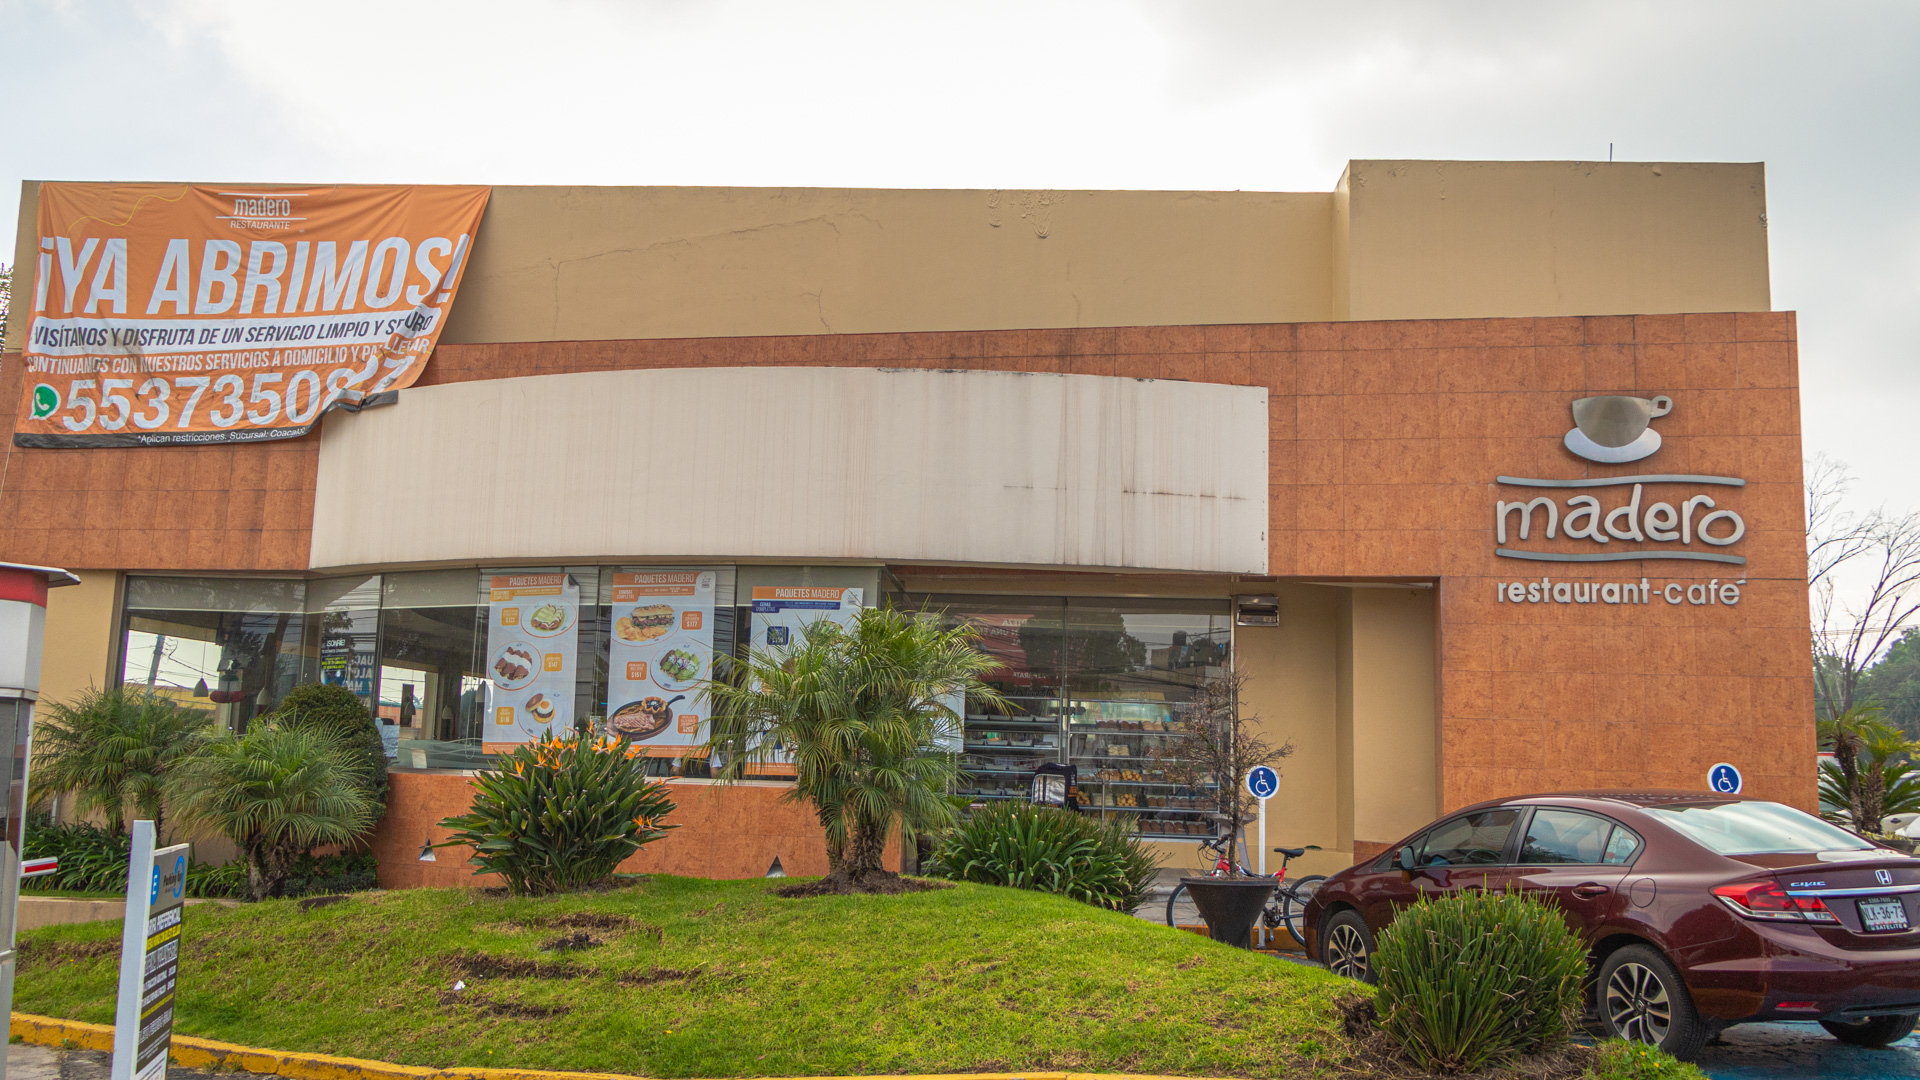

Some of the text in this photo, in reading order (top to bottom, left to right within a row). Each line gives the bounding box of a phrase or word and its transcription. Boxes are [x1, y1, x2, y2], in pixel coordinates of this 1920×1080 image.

[233, 196, 291, 216] madero
[231, 220, 290, 229] RESTAURANTE
[147, 233, 471, 315] ABRIMOS!
[34, 325, 108, 348] VISÍTANOS
[111, 328, 121, 347] Y
[123, 328, 195, 347] DISFRUTA
[198, 328, 220, 345] DE
[221, 327, 244, 344] UN
[245, 324, 316, 343] SERVICIO
[316, 320, 369, 340] LIMPIO
[374, 319, 384, 336] Y
[112, 356, 137, 374] CON
[140, 354, 203, 373] NUESTROS
[205, 351, 270, 371] SERVICIOS
[271, 350, 281, 367] A
[284, 347, 348, 367] DOMICILIO
[351, 346, 360, 363] Y
[173, 433, 227, 442] restricciones.
[230, 431, 268, 440] Sucursal:
[1496, 484, 1746, 546] madero
[510, 575, 561, 586] PAQUETES MADERO
[635, 574, 694, 583] PAQUETES MADERO
[776, 589, 840, 598] PAQUETES MADERO
